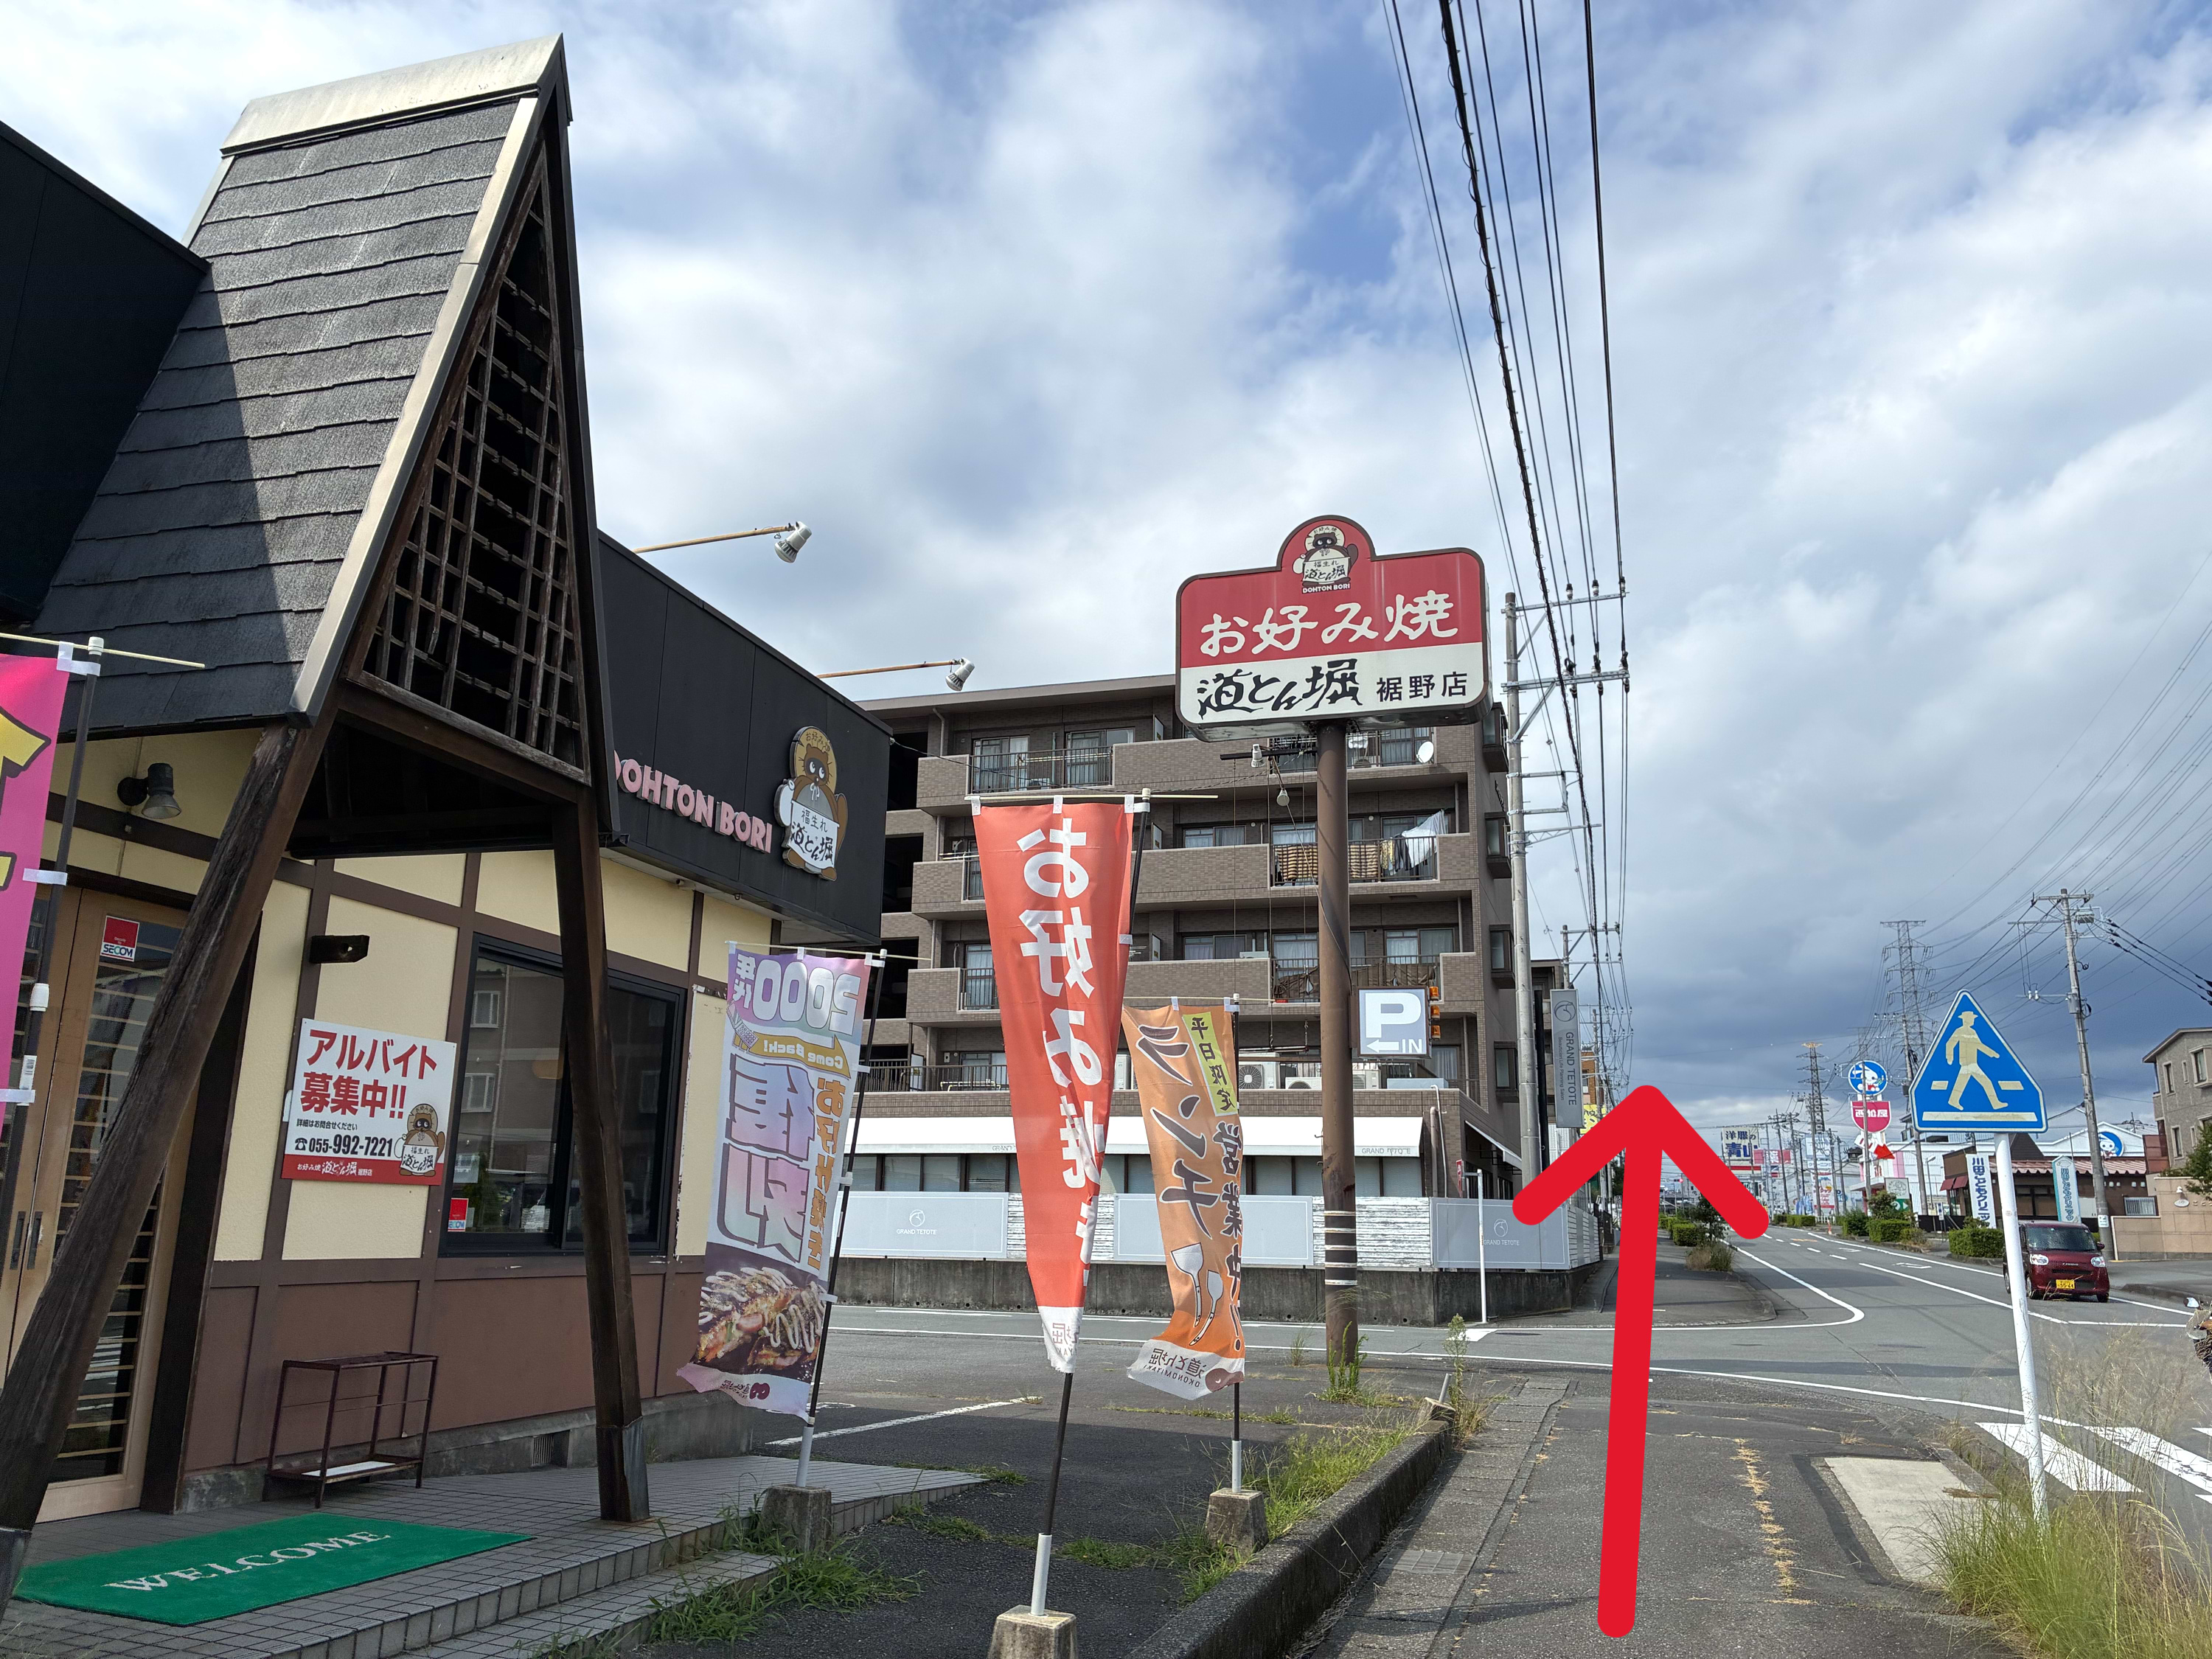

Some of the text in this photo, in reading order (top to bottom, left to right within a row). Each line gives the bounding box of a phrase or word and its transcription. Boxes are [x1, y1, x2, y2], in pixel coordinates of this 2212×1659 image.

[1302, 585, 1332, 594] DOHTON
[1200, 589, 1458, 657] お好み焼
[1197, 658, 1468, 720] 道とん堀 裾野店
[613, 750, 773, 854] OHTON BORI
[801, 808, 828, 832] 福生れ
[790, 821, 834, 865] 道とん堀
[103, 944, 133, 957] SECOM
[1365, 992, 1422, 1038] P
[307, 1029, 437, 1080] アルバイト
[1402, 1039, 1422, 1054] IN
[1565, 1032, 1577, 1105] GRAND TETOTE
[300, 1071, 407, 1119] 募集中!!
[296, 1118, 358, 1131] 詳細はお問合せください
[1855, 1109, 1888, 1117] 西松屋
[308, 1134, 393, 1157] 055-992-7221
[1725, 1130, 1756, 1141] 洋服の
[321, 1161, 357, 1176] 道とん堀
[402, 1154, 434, 1172] 道とん堀
[448, 1220, 465, 1228] ECOM
[100, 1531, 392, 1591] WELCOME
